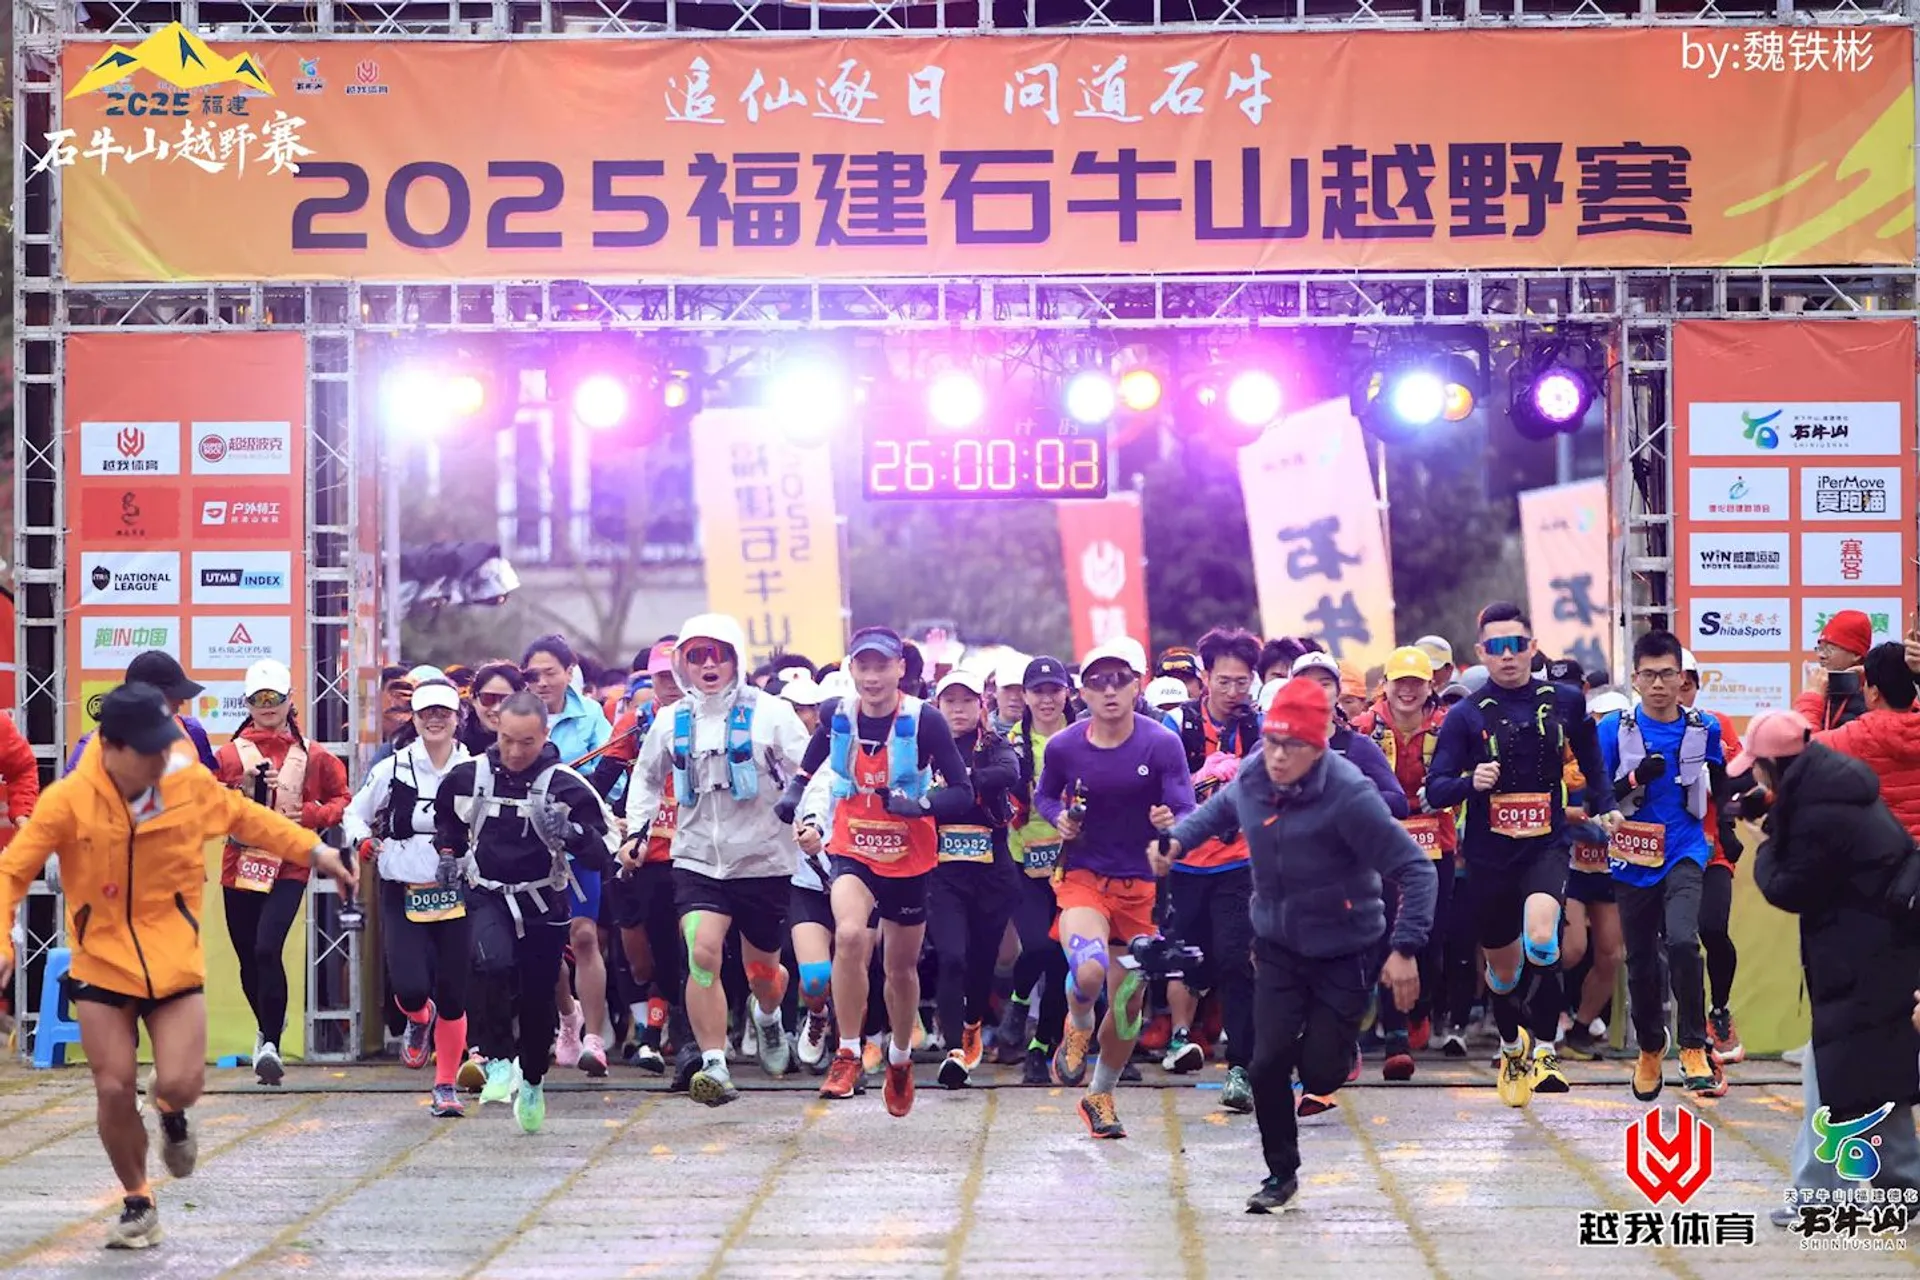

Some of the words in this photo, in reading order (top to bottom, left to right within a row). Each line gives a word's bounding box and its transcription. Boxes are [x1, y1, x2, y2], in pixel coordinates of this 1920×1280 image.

[664, 56, 946, 124] 追仙逐日
[1004, 53, 1274, 125] 问道石牛
[291, 141, 1693, 250] 2025福建石牛山越野赛
[1790, 424, 1848, 440] 石牛山
[228, 437, 283, 451] 超级波克
[102, 460, 158, 471] 越我体育
[1817, 476, 1885, 489] iPerMove
[231, 502, 281, 515] 户外特工
[114, 573, 171, 582] NATIONAL
[205, 573, 237, 583] UTMB
[244, 576, 281, 586] INDEX
[114, 582, 158, 591] LEAGUE
[1699, 611, 1782, 637] ShibaSports
[94, 627, 168, 648] 跑IN中国
[1498, 808, 1546, 821] C0191
[855, 834, 902, 846] C0323
[944, 838, 987, 850] D0382
[1030, 850, 1059, 863] D03
[412, 891, 457, 906] D0053
